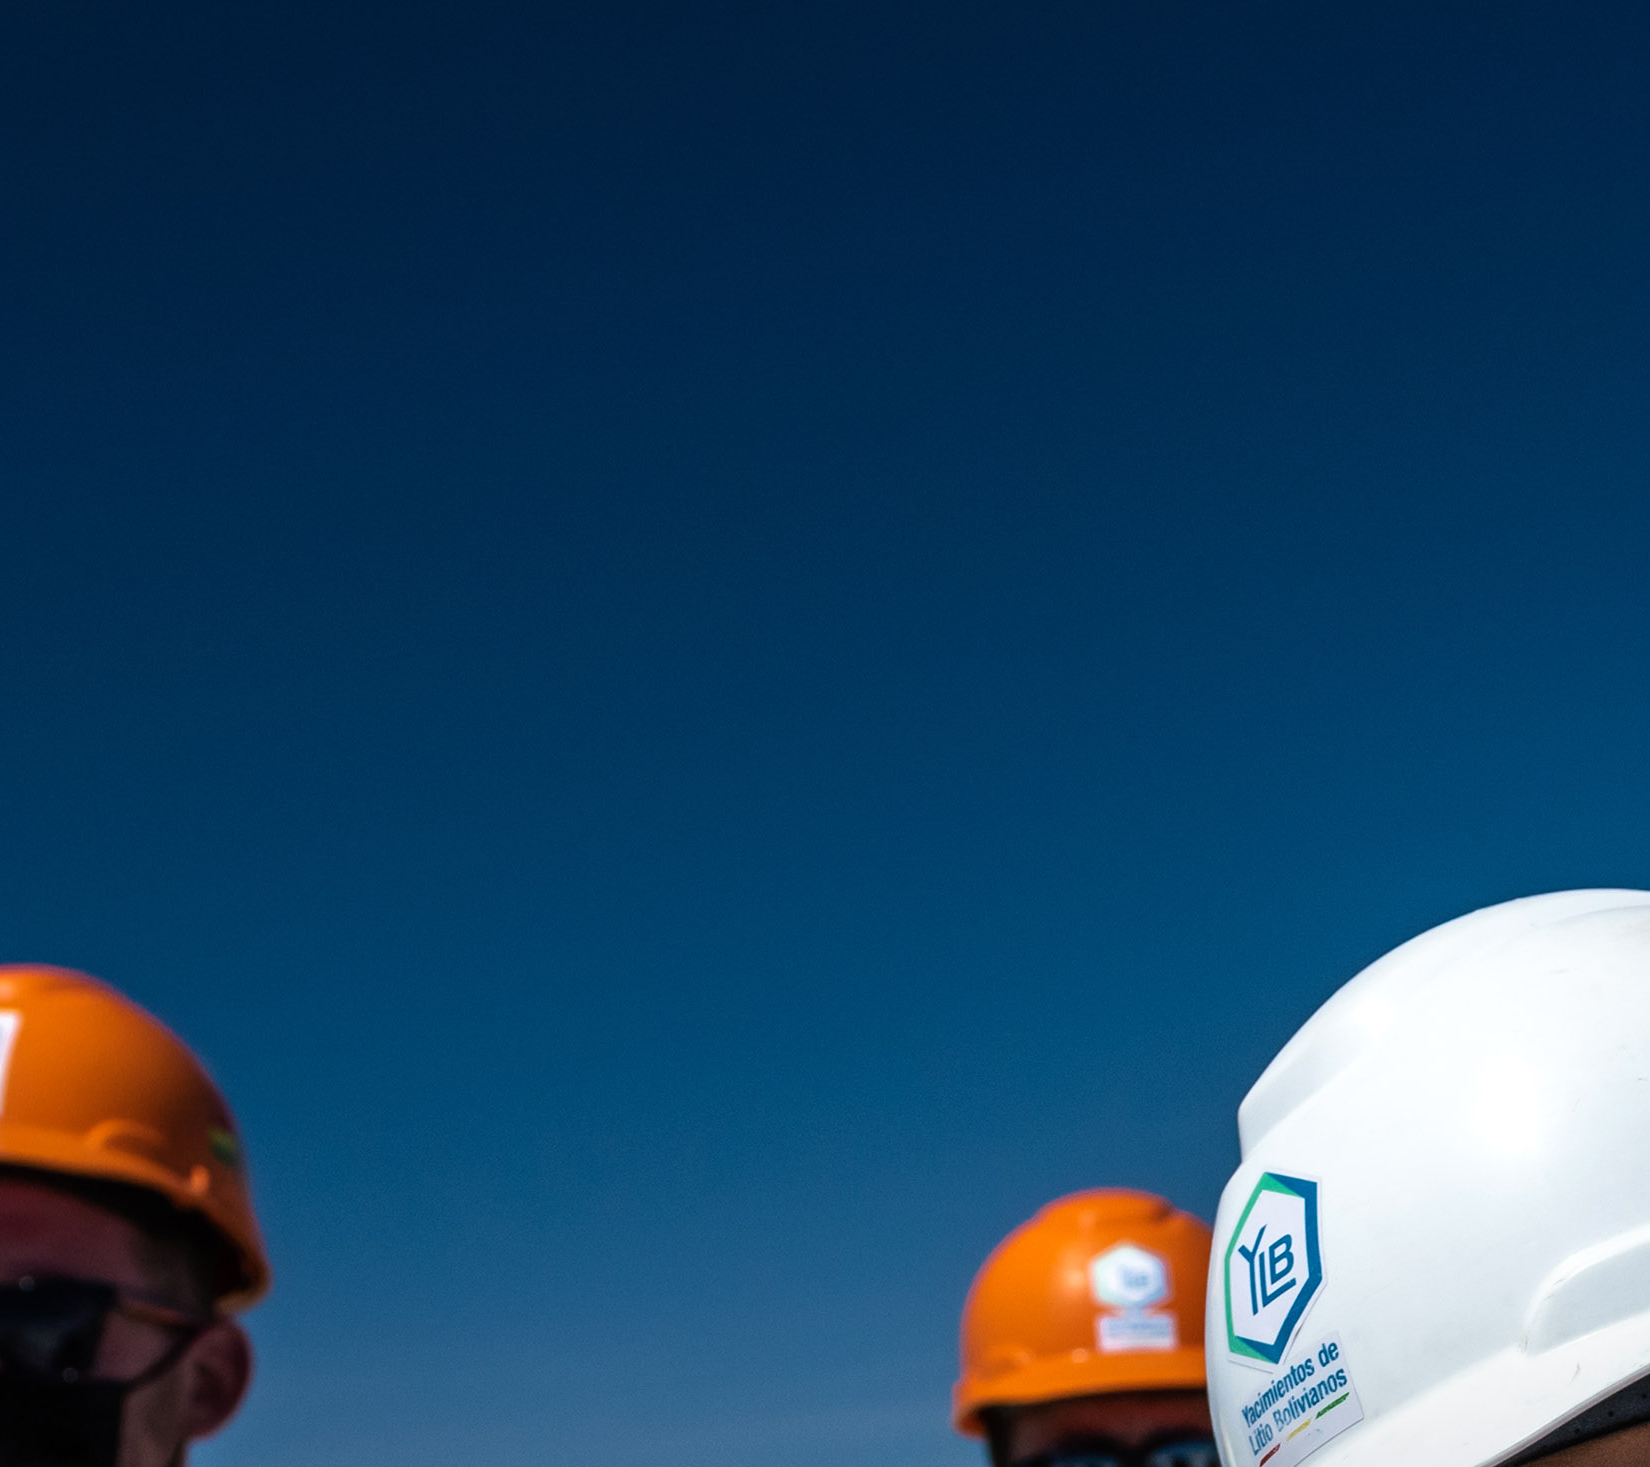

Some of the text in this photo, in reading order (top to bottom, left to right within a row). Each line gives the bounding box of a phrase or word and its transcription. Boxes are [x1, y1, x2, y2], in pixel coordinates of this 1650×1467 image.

[1238, 1224, 1297, 1316] YLB
[1241, 1342, 1340, 1428] Yacimientos de
[1248, 1368, 1348, 1456] Litio Bolivianos
